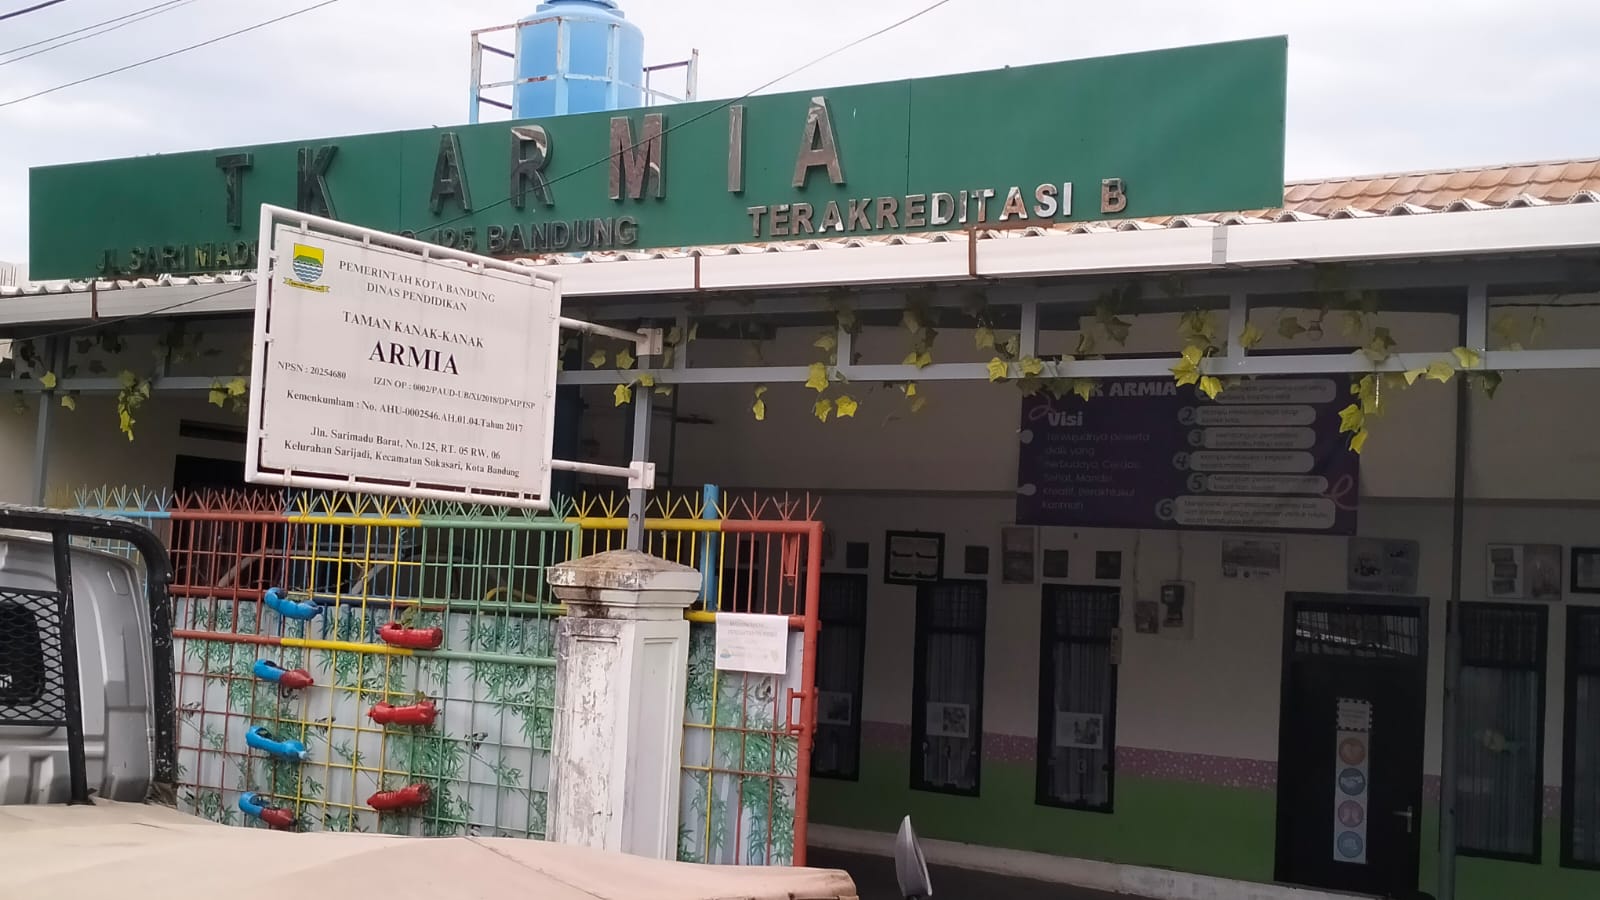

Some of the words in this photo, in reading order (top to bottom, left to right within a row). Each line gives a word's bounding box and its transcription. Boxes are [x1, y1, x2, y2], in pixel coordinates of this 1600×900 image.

[746, 181, 1073, 237] TERAKREDITASI
[1101, 177, 1127, 213] B
[487, 216, 638, 252] BANDUNG
[339, 260, 412, 285] PEMERINTAH
[415, 277, 443, 292] KOTA
[446, 284, 495, 303] BANDUNG
[367, 282, 400, 297] DINAS
[402, 290, 467, 311] PENDIDIKAN
[343, 311, 391, 331] TAMAN
[394, 320, 484, 348] KANAK-KANAK
[278, 361, 303, 373] NPSN
[310, 366, 347, 379] 20254680
[368, 340, 459, 375] ARMIA
[373, 376, 392, 387] IZIN
[1109, 381, 1177, 397] ARMIA
[286, 389, 354, 408] Kemenkumham
[362, 400, 377, 411] No.
[506, 422, 523, 432] 2017
[1048, 411, 1083, 426] Visi
[284, 439, 332, 455] Kelurahan
[334, 445, 373, 460] Sarijadi,
[375, 451, 422, 466] Kecamatan
[424, 456, 463, 471] Sukasari,
[465, 462, 485, 473] Kota
[487, 464, 520, 478] Bandung
[310, 426, 328, 438] Jln.
[330, 429, 374, 443] Sarimadu
[376, 435, 403, 448] Barat,
[440, 443, 456, 454] RT.
[458, 446, 469, 456] 05
[471, 447, 489, 459] RW.
[491, 450, 501, 460] 06
